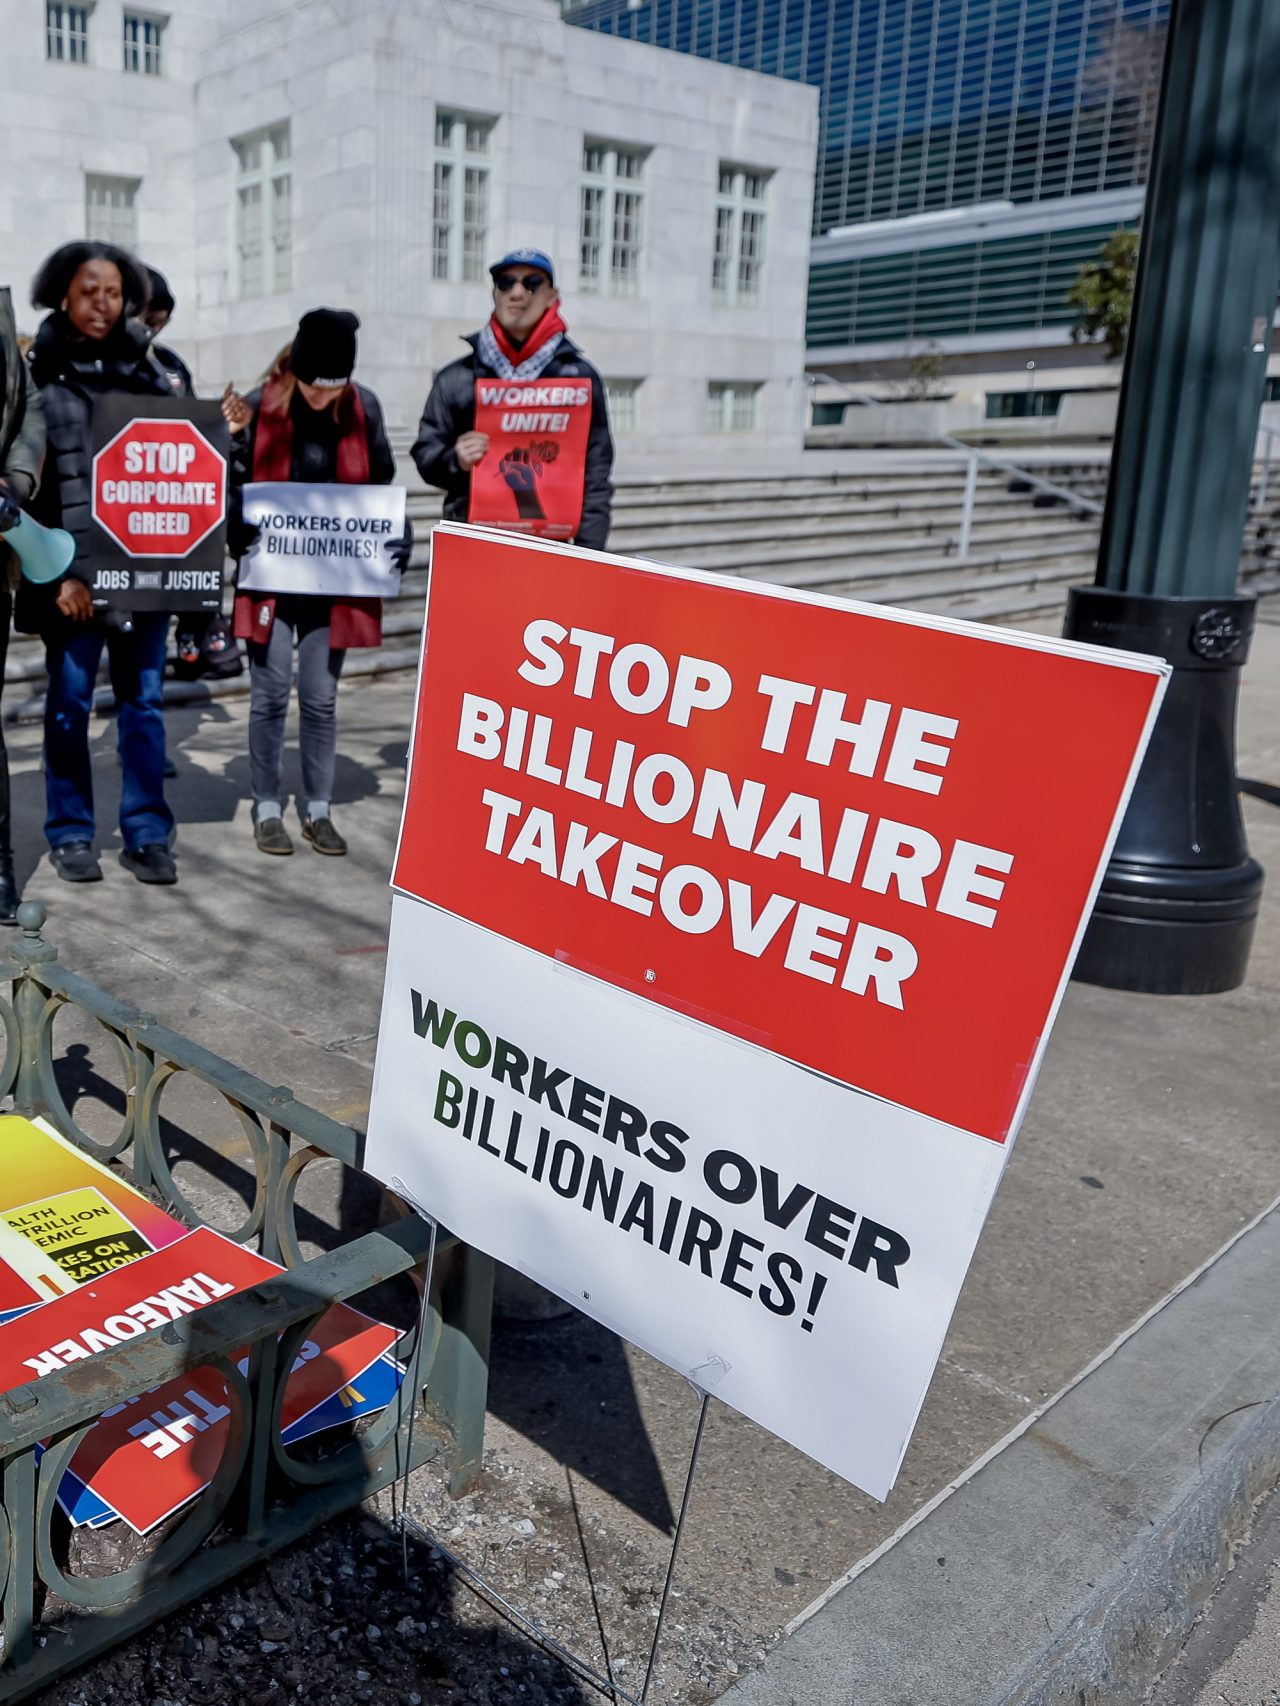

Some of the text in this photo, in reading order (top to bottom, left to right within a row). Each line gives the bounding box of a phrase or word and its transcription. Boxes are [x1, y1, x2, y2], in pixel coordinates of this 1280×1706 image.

[480, 386, 589, 407] WORKERS
[500, 412, 570, 433] UNITE!
[124, 441, 196, 474] STOP
[102, 480, 216, 506] CORPORATE
[127, 511, 190, 535] GREED
[258, 513, 393, 535] WORKERS OVER
[266, 534, 378, 560] BILLIONAIRES!
[92, 570, 130, 591] JOBS
[163, 570, 220, 591] JUSTICE
[517, 618, 960, 797] STOP THE
[456, 691, 1014, 929] BILLIONAIRE
[481, 788, 919, 1012] TAKEOVER
[410, 987, 912, 1290] WORKERS OVER
[433, 1069, 829, 1335] BILLIONAIRES!
[18, 1206, 110, 1238] TRILLION
[94, 1240, 130, 1257] ON
[21, 1271, 236, 1378] TAKEOVER
[127, 1389, 231, 1460] THE
